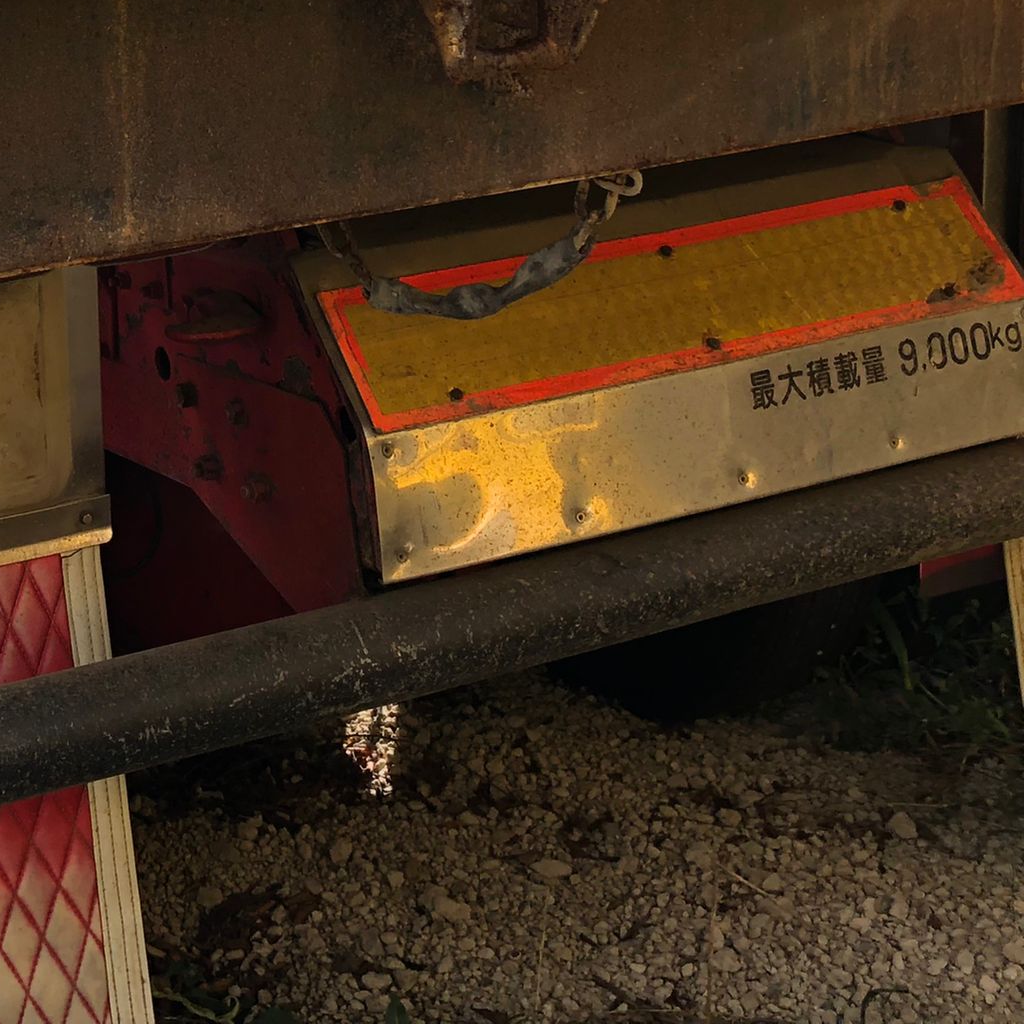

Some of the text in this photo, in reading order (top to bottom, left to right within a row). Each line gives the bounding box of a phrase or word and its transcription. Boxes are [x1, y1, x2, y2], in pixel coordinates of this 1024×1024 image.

[750, 345, 888, 410] 最大積載量
